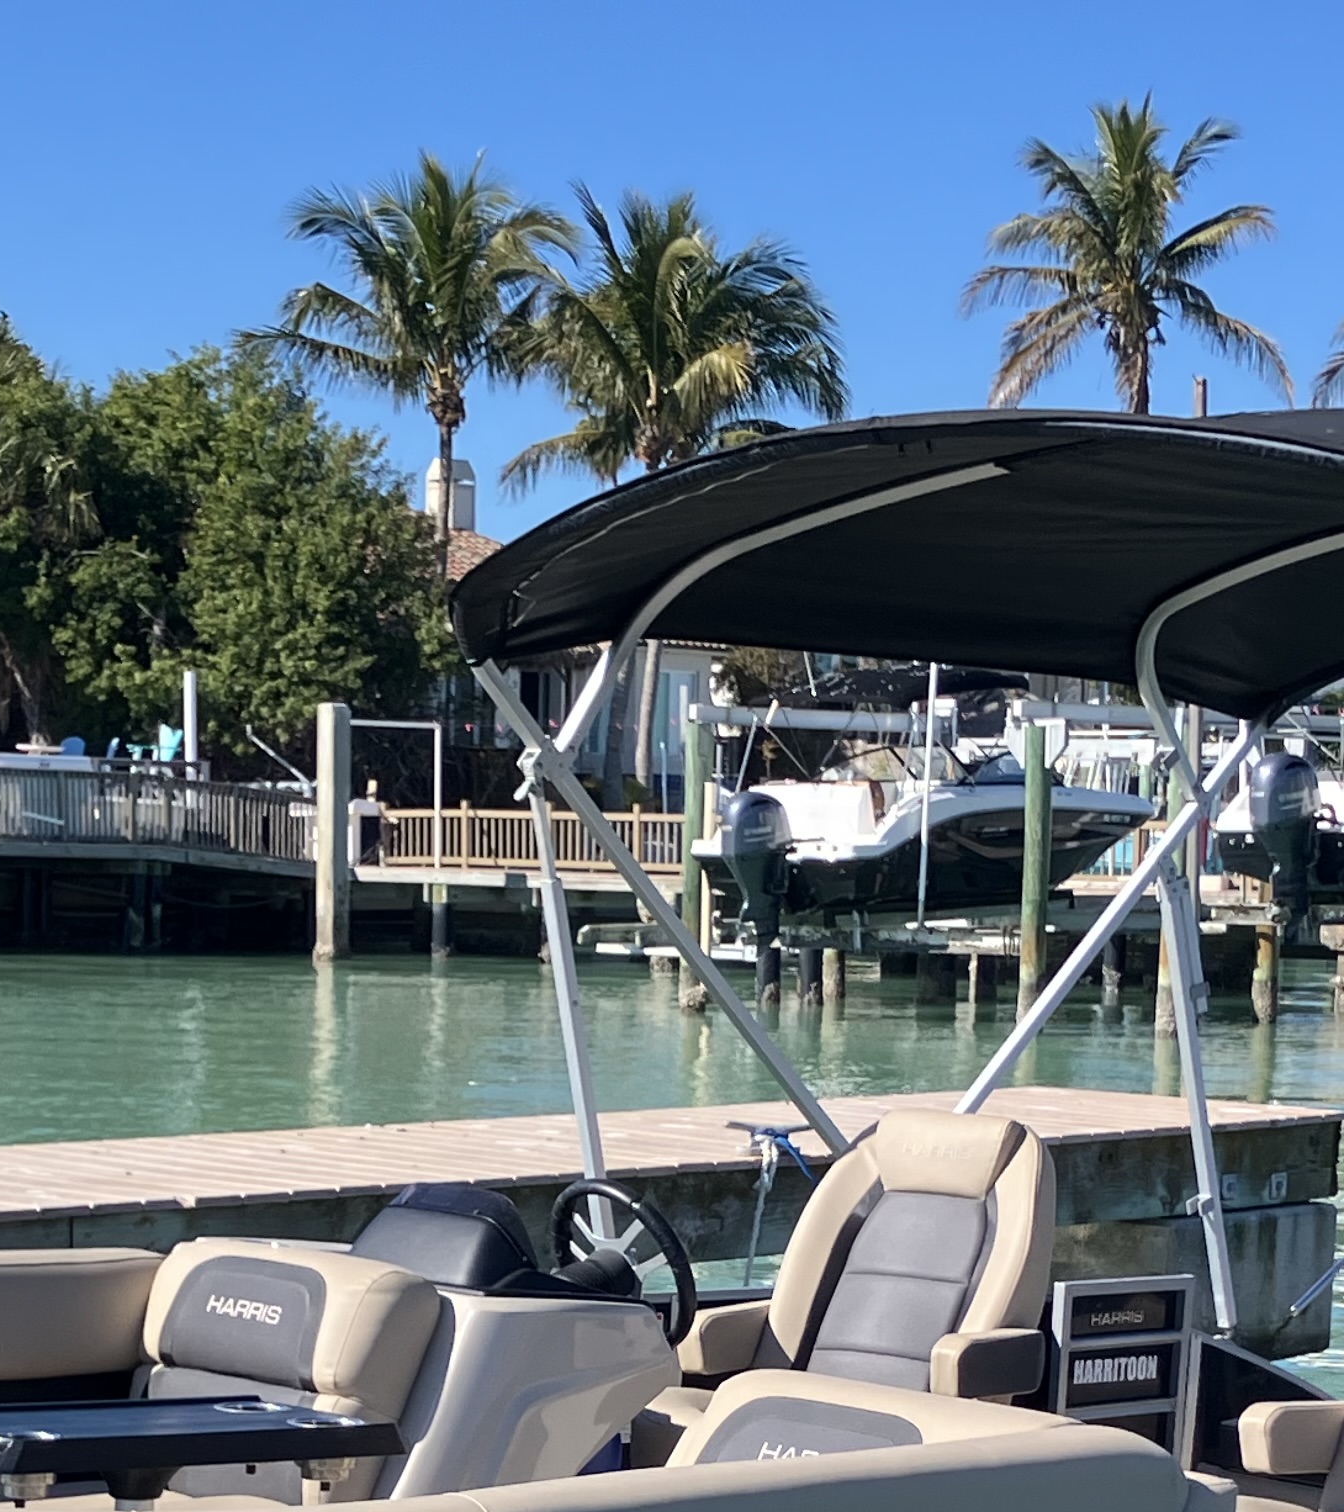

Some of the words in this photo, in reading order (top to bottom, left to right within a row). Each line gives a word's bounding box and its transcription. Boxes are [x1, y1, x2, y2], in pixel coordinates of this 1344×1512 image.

[206, 1294, 283, 1325] HARRIS
[1090, 1309, 1145, 1327] HARRIS
[1072, 1354, 1159, 1385] HARRITOON
